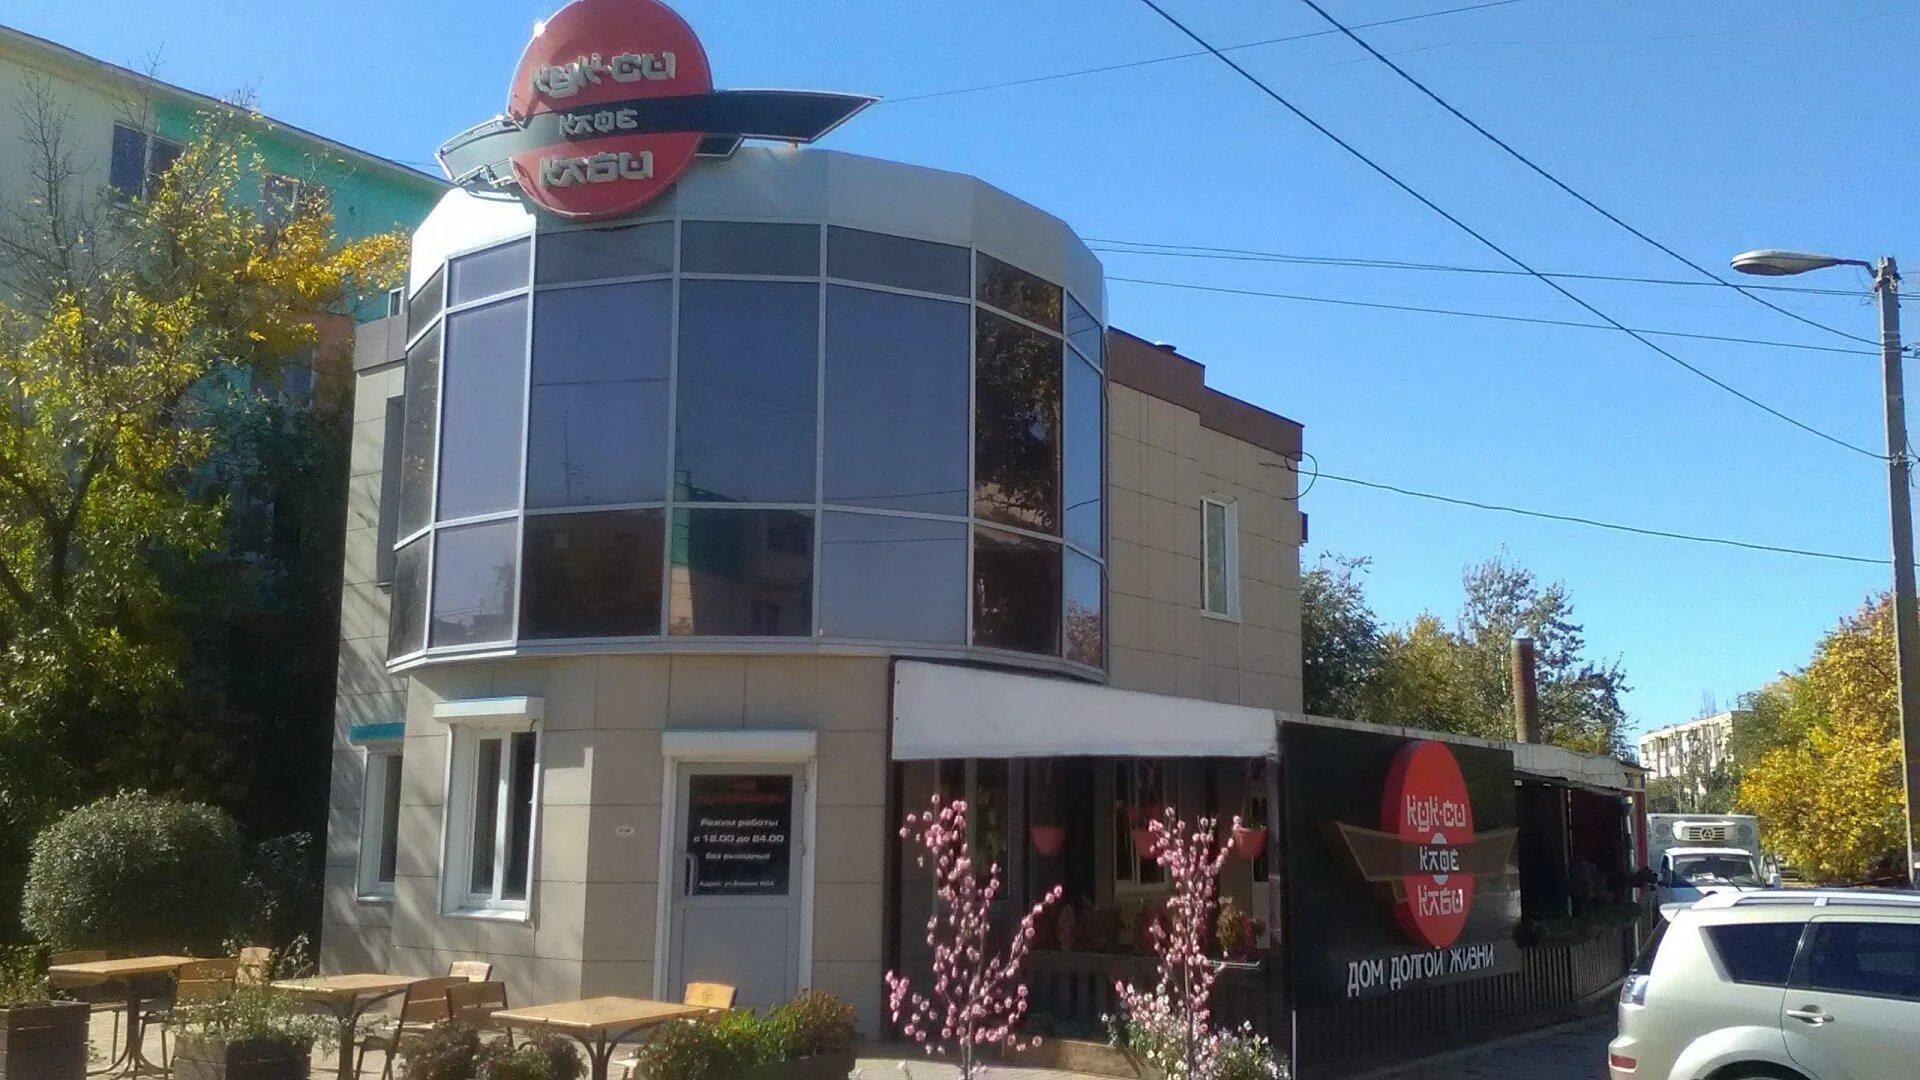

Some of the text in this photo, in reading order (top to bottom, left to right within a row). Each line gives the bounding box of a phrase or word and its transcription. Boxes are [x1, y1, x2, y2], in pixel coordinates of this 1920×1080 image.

[737, 818, 779, 828] работы
[736, 836, 750, 844] до
[1347, 944, 1495, 997] ДОМ ДОЛГОЙ ЖИЗНИ
